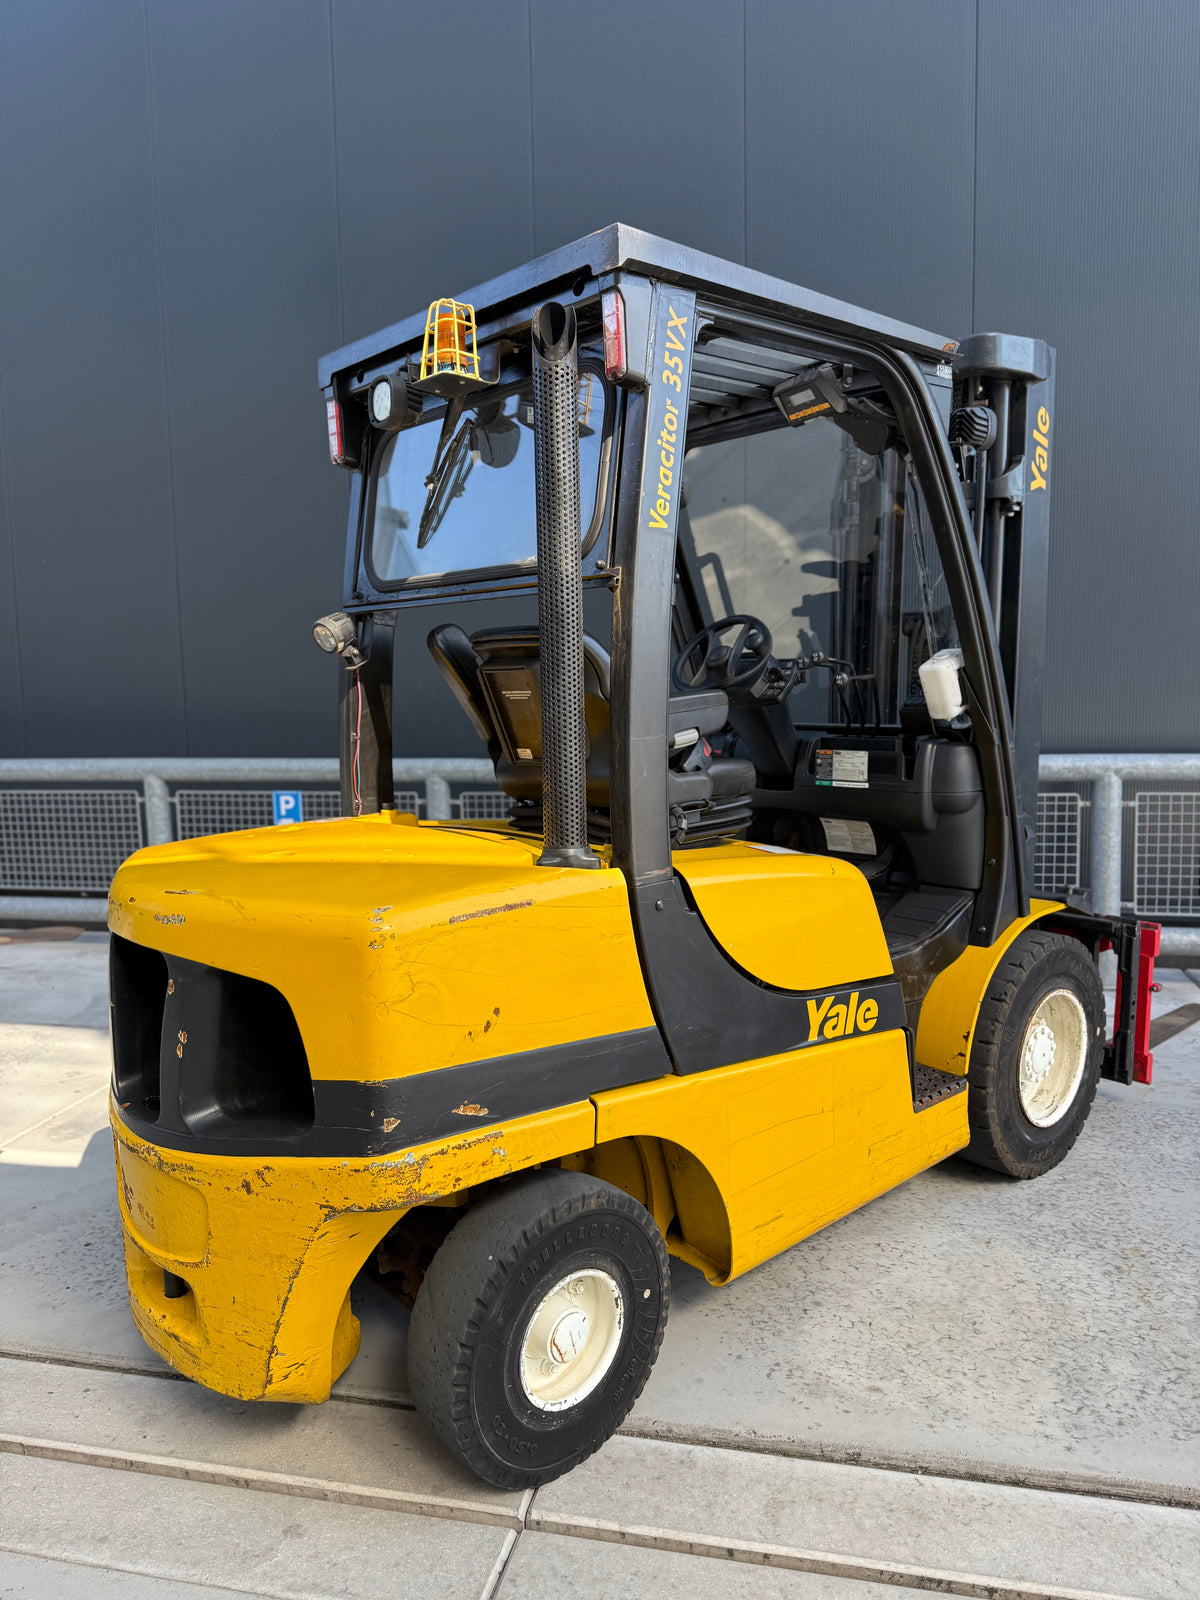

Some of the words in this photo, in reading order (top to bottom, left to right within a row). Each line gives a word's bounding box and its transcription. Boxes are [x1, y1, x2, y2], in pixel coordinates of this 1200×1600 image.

[662, 305, 688, 393] 35VX
[648, 398, 679, 531] Veracitor
[1028, 406, 1050, 493] Yale
[279, 795, 296, 816] P
[806, 991, 879, 1042] Yale
